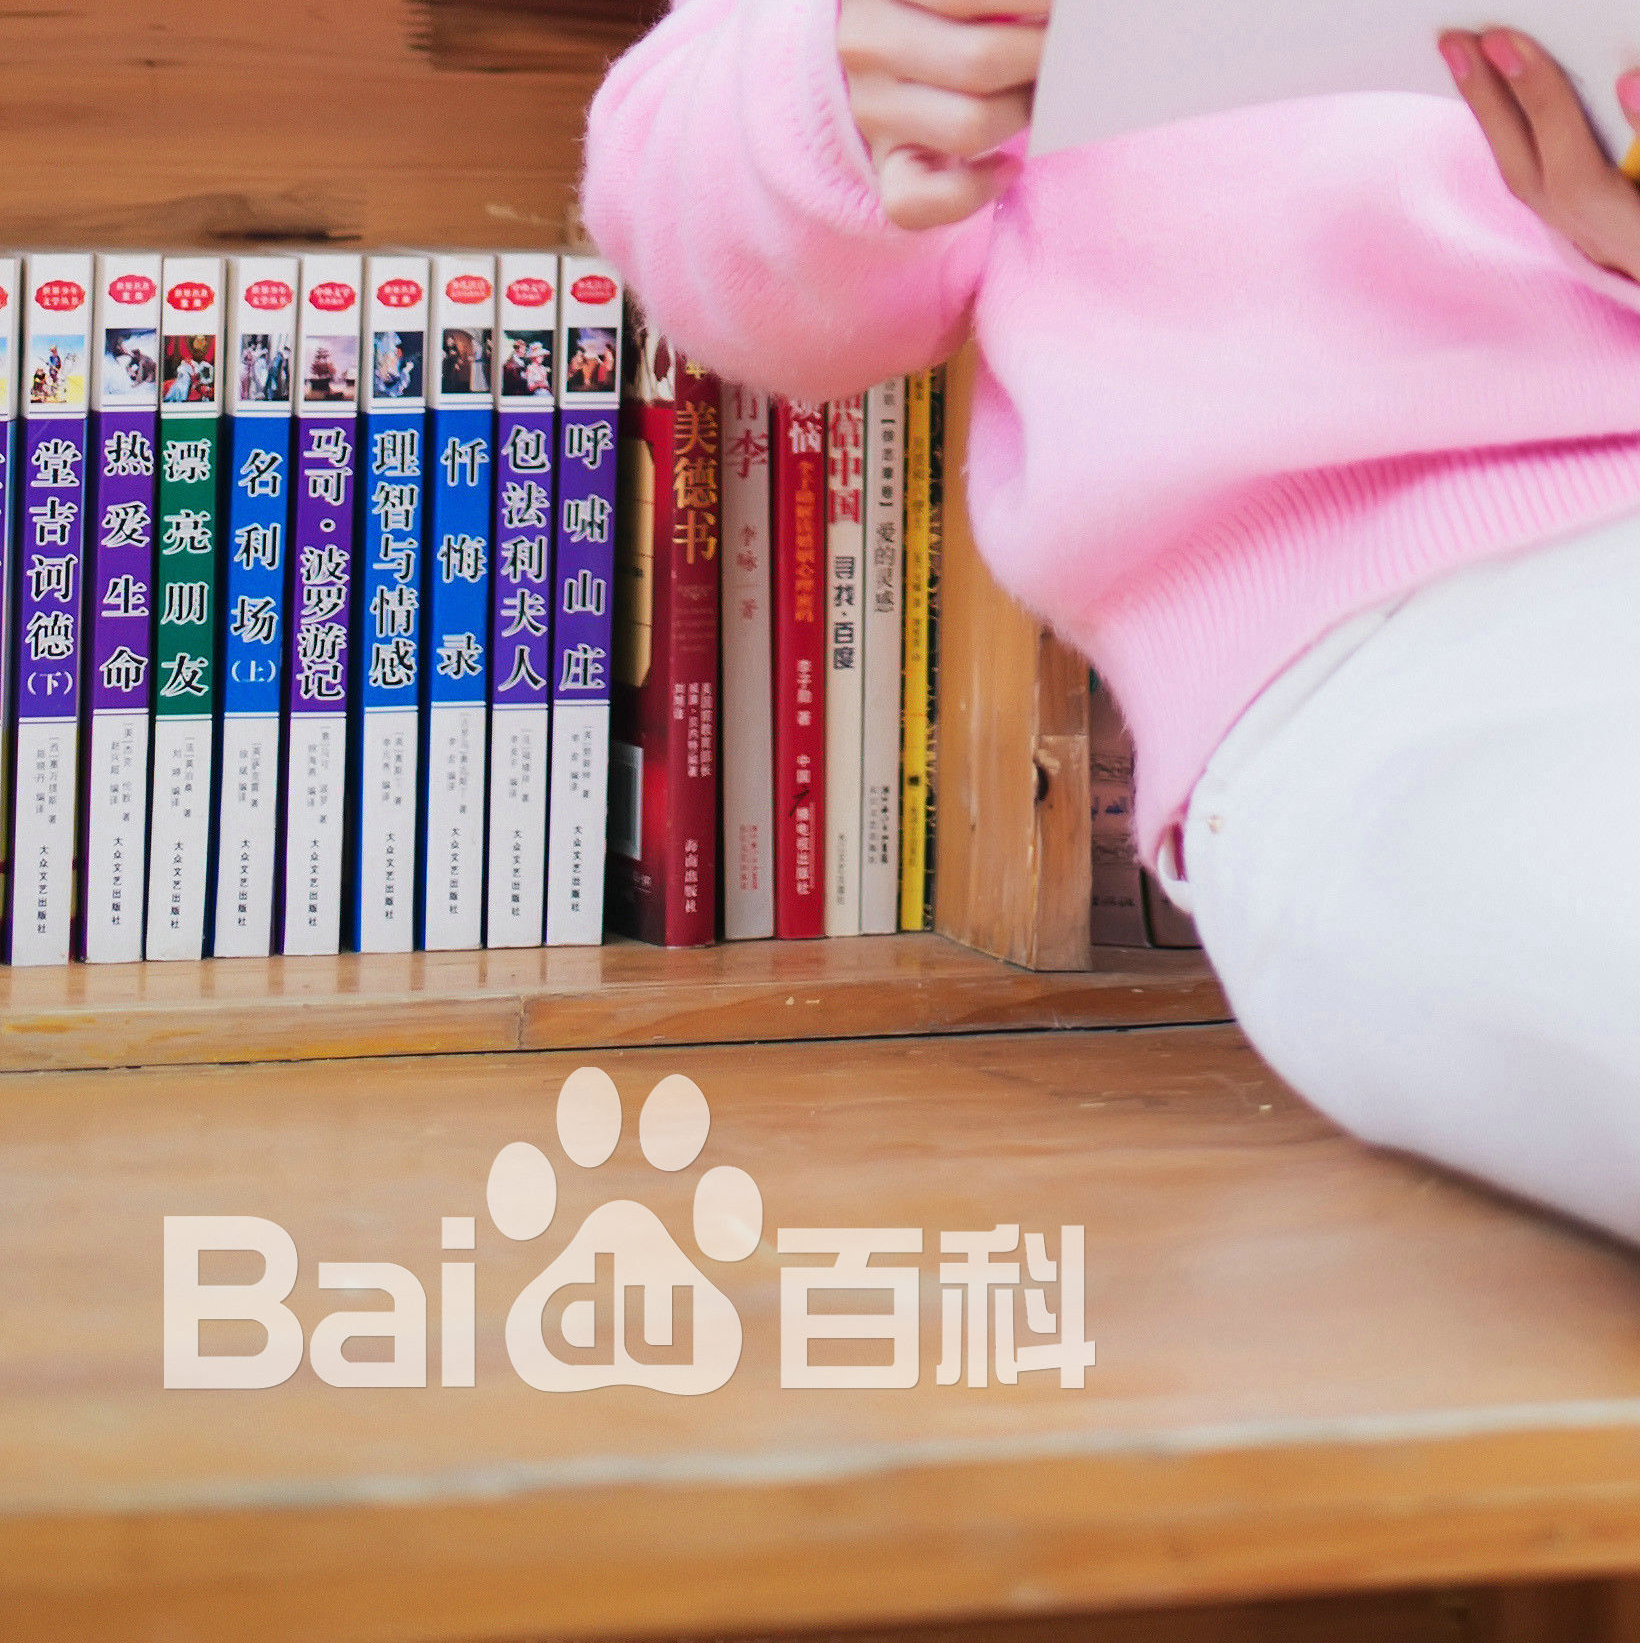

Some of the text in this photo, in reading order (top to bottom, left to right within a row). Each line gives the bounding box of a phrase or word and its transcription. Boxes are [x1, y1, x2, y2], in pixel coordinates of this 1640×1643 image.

[673, 400, 718, 564] 美德书
[100, 430, 154, 692] 热爱生命
[160, 438, 213, 697] 漂亮朋友
[368, 428, 421, 689] 理智与情感
[437, 436, 490, 679] 忏悔录
[498, 424, 551, 691] 包法利夫人
[558, 420, 614, 691] 呼啸山庄
[37, 845, 50, 934] 大众文艺出版社
[111, 836, 124, 925] 大众文艺出版社
[170, 841, 183, 929] 大众文艺出版社
[238, 839, 250, 926] 大众文艺出版社
[308, 839, 320, 926] 大众文艺出版社
[385, 832, 396, 919] 大众文艺出版社
[449, 827, 461, 915] 大众文艺出版社
[511, 829, 523, 917] 大众文艺出版社
[571, 825, 583, 913] 大众文艺出版社
